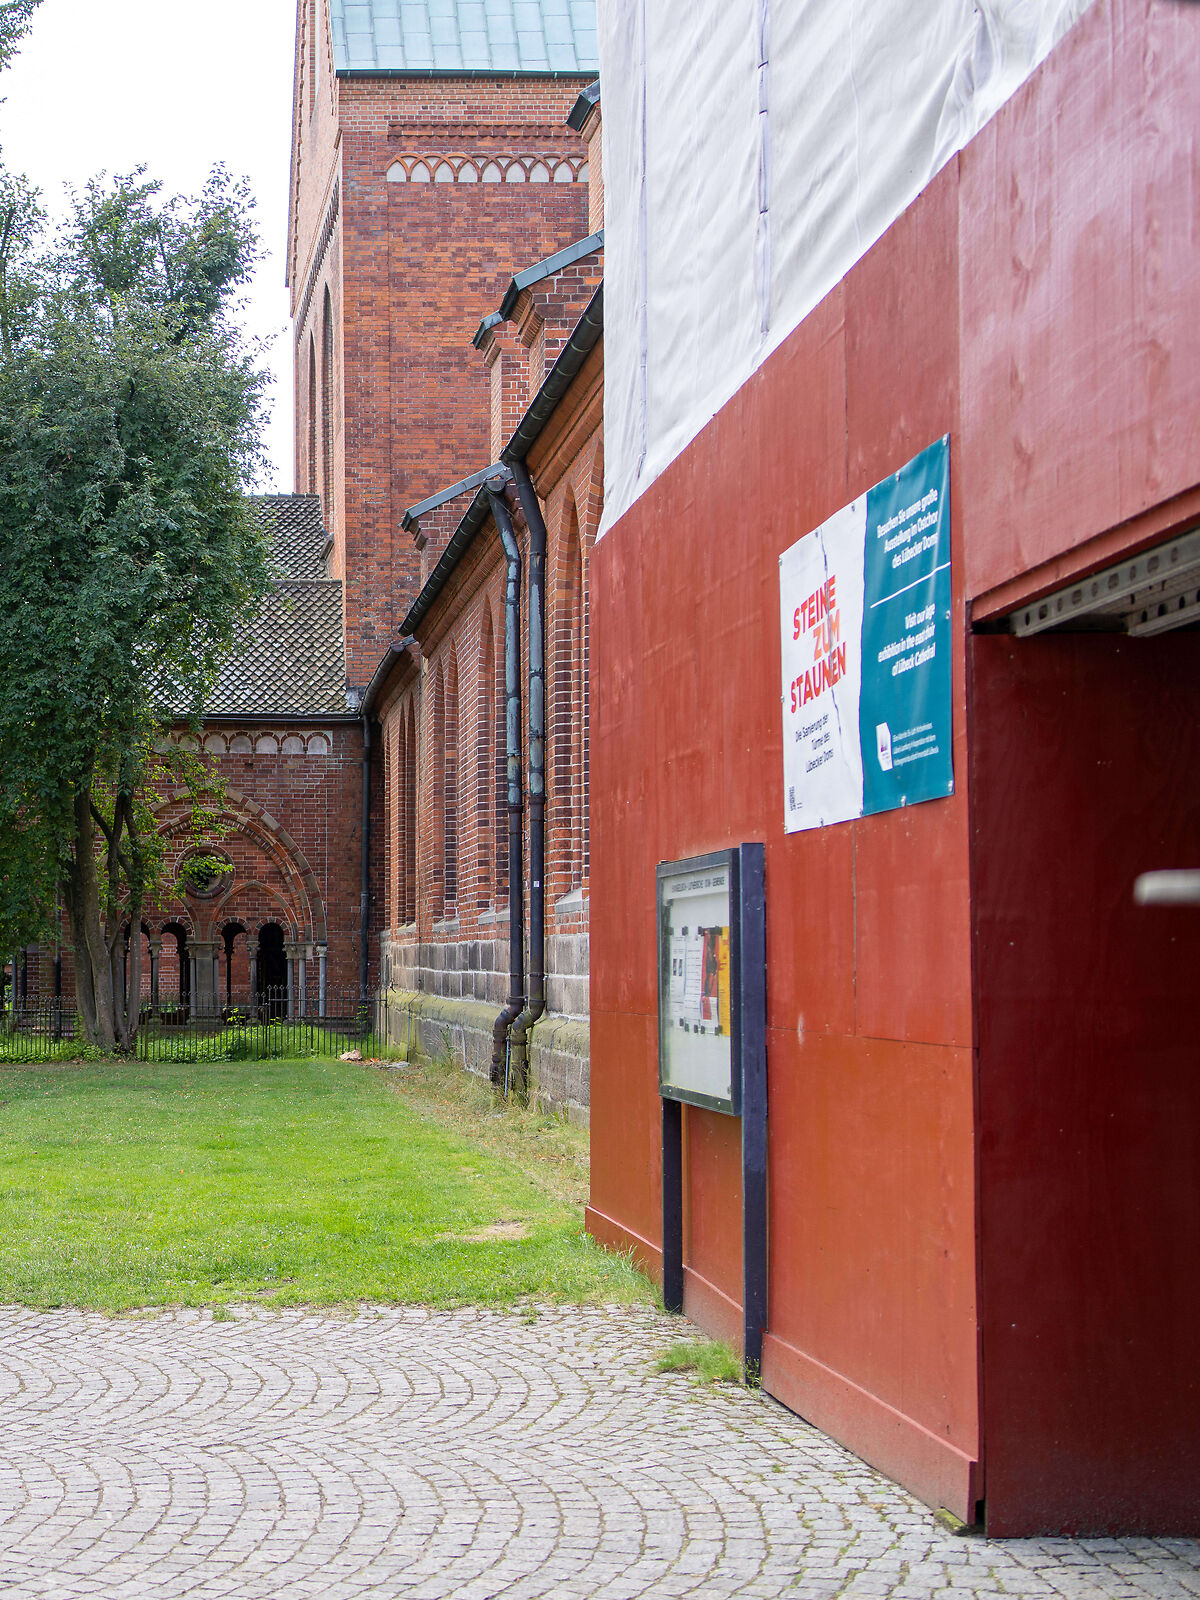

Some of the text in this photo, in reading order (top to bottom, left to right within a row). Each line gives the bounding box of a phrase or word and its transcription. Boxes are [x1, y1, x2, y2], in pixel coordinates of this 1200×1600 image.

[898, 508, 906, 524] Sie
[793, 574, 836, 640] STEINE
[813, 608, 840, 661] ZUM
[790, 641, 846, 714] STAUNEN
